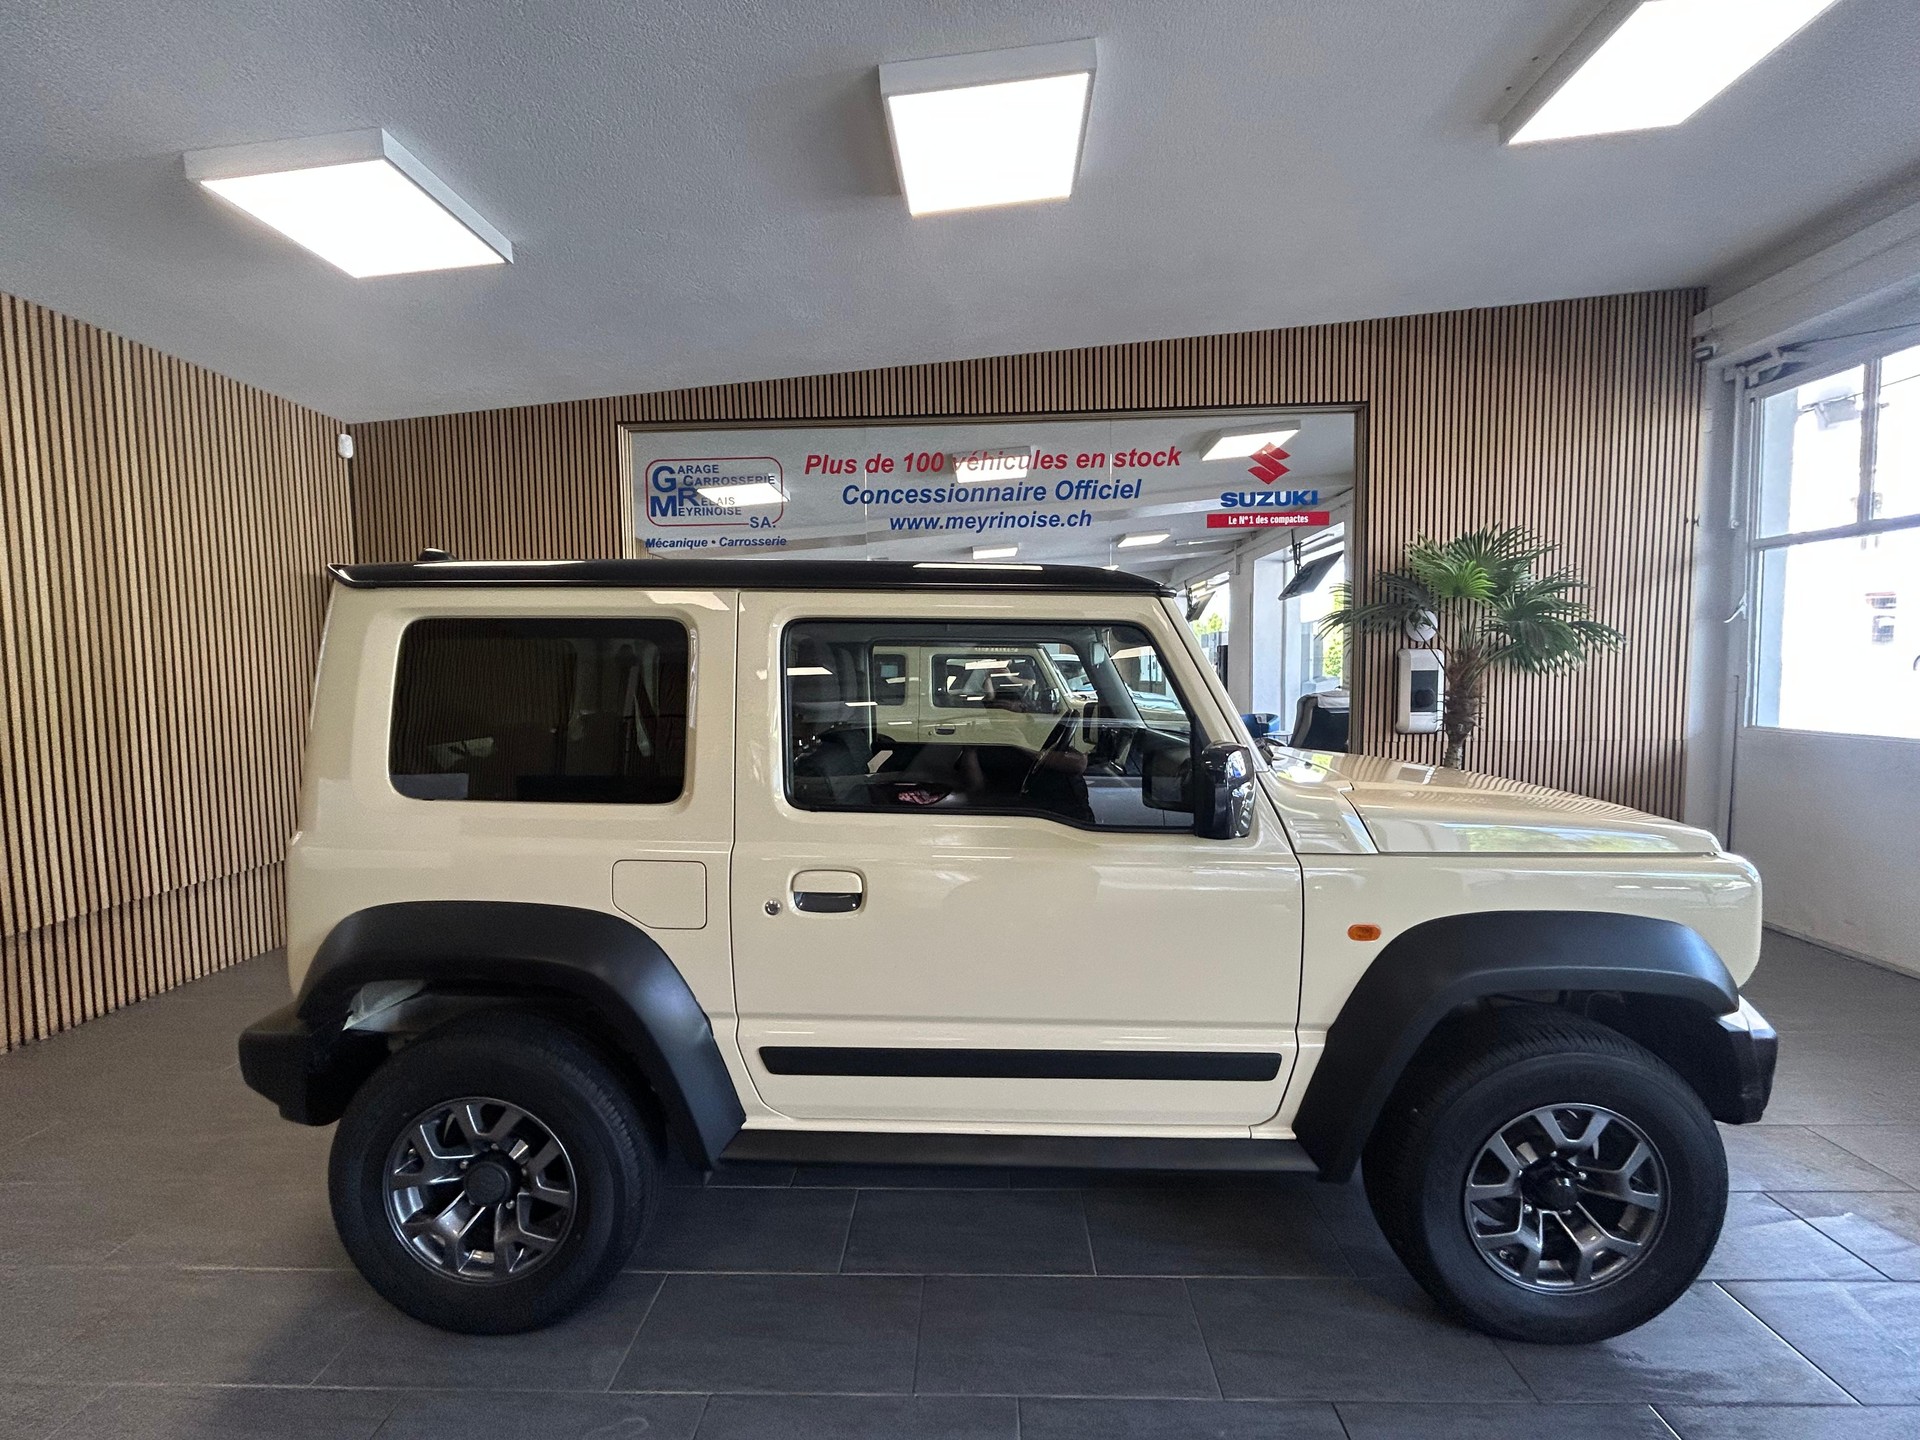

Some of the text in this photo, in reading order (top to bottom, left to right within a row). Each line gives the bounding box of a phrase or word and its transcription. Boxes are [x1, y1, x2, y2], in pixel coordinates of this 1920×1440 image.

[804, 446, 1182, 475] Plus de 100 véhicules en stock
[652, 464, 719, 493] GARAGE
[683, 475, 776, 488] CARROSSERIE
[842, 479, 1142, 505] Concessionnaire Officiel
[1220, 490, 1318, 508] SUZUKI
[650, 495, 742, 518] MEYRINOISE
[890, 509, 1092, 534] www.meyrinoise.ch
[1228, 516, 1237, 525] Le
[1255, 515, 1268, 524] des
[1270, 514, 1309, 525] compactes
[645, 536, 787, 549] Mécanique Carrosserie
